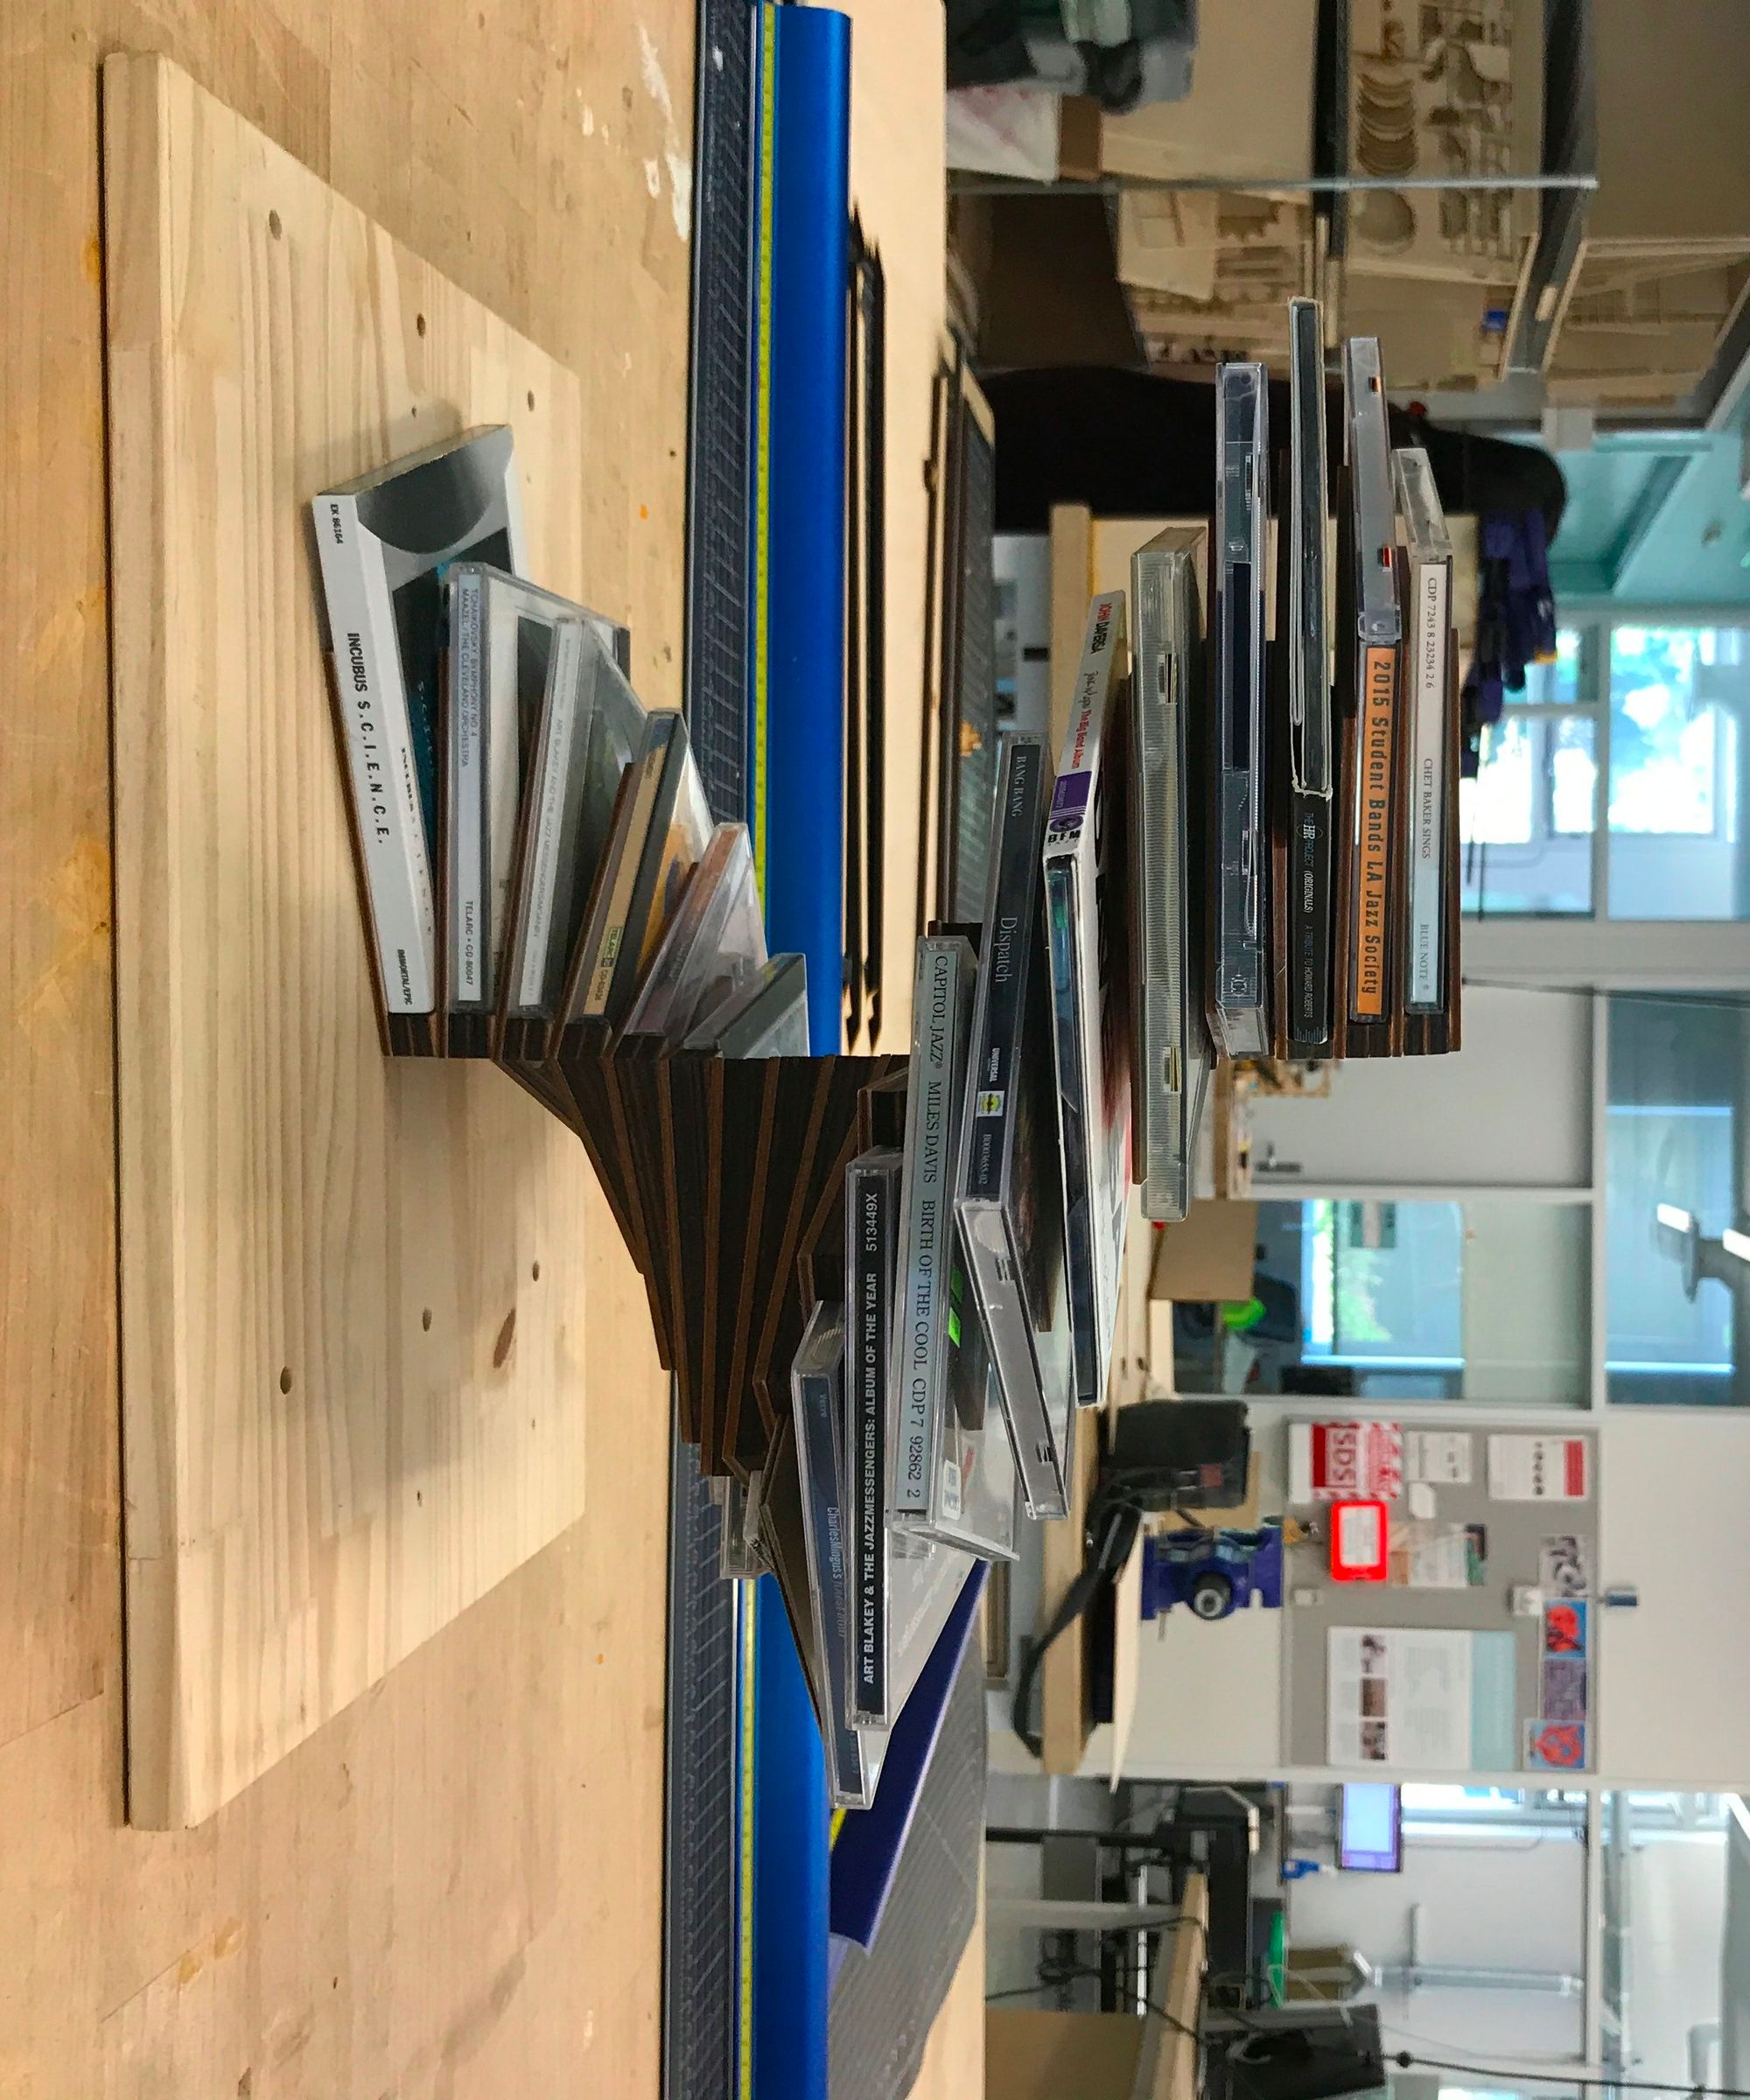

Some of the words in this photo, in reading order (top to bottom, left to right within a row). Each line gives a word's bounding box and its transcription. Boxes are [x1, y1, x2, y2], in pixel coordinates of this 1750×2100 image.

[331, 504, 340, 515] EK
[332, 517, 344, 544] 86164
[1427, 578, 1438, 602] CDP
[1097, 602, 1112, 622] JOHN
[1426, 605, 1436, 629] 7243
[461, 633, 470, 651] THE
[1425, 640, 1435, 670] 23234
[346, 632, 368, 692] INCUBUS
[461, 653, 470, 708] CLEVELAND
[470, 658, 479, 711] SYMPHONY
[1372, 661, 1391, 707] 2015
[461, 710, 470, 767] ORCHESTRA
[1368, 717, 1390, 790] Student
[1014, 756, 1027, 784] BANG
[1423, 758, 1433, 788] CHET
[1011, 788, 1024, 817] BANG
[1422, 791, 1432, 824] BAKER
[1368, 798, 1386, 852] Bands
[1421, 828, 1432, 859] SINGS
[1366, 861, 1384, 883] LA
[1303, 870, 1314, 914] (ORIGINALS)
[1365, 890, 1382, 928] Jazz
[465, 900, 473, 935] TELARC
[994, 917, 1018, 983] Dispatch
[1304, 932, 1313, 957] TRIBUTE
[1419, 923, 1430, 950] BLUE
[397, 948, 413, 1005] IMMORTAL/EPIC
[1303, 966, 1312, 991] HOWARD
[1362, 934, 1381, 995] Society
[1418, 952, 1429, 981] NOTE
[932, 956, 948, 1023] CAPITOL
[1303, 992, 1312, 1018] ROBERTS
[988, 1047, 1001, 1082] UNIVERSAL
[927, 1081, 942, 1130] MILES
[924, 1135, 939, 1183] DAVIS
[865, 1193, 878, 1251] 513449X
[920, 1200, 936, 1250] BIRTH
[918, 1255, 933, 1278] OF
[865, 1272, 878, 1310] YEAR
[917, 1280, 932, 1317] THE
[864, 1313, 877, 1342] THE
[864, 1345, 877, 1363] OF
[913, 1321, 929, 1370] COOL
[864, 1367, 877, 1415] ALBUM
[911, 1378, 927, 1415] CDP
[910, 1418, 924, 1427] 7
[907, 1436, 923, 1480] 92862
[1333, 1432, 1356, 1482] SDS
[907, 1488, 920, 1498] 2
[864, 1554, 875, 1580] THE
[863, 1598, 874, 1653] BLAKEY
[864, 1656, 874, 1684] ART
